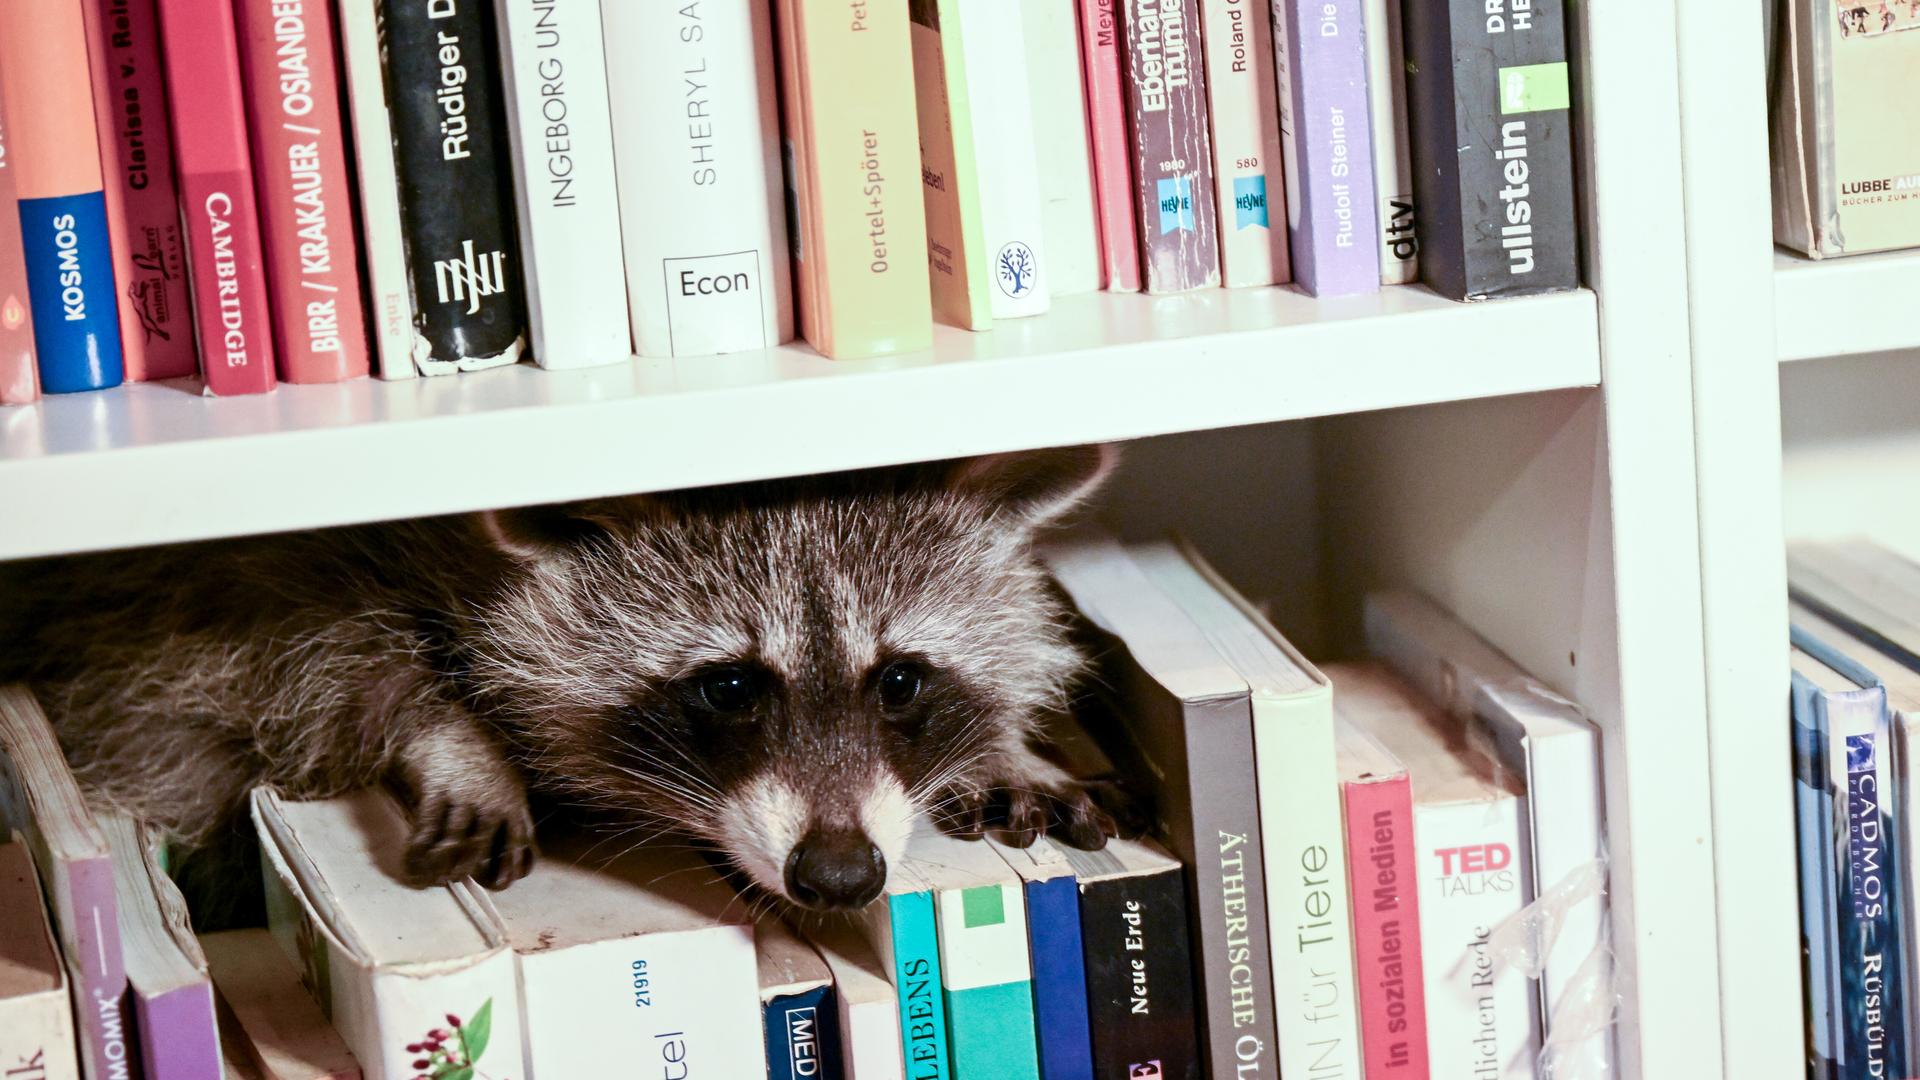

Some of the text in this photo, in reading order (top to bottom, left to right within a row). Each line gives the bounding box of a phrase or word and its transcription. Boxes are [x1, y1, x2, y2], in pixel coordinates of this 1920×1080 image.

[272, 0, 314, 117] OSIANDE
[1230, 10, 1246, 73] Roland
[1320, 4, 1339, 37] Die
[121, 88, 149, 190] Clarissa
[436, 30, 470, 161] Rüdiger
[532, 0, 576, 207] INGEBORG UN
[678, 1, 717, 186] SHERYL SA
[288, 141, 331, 274] KRAKAUER
[860, 129, 888, 274] Oertel+Spörer
[1236, 158, 1258, 169] 580
[1329, 106, 1353, 247] Rudolf Steiner
[1495, 121, 1535, 274] ullstein
[53, 214, 86, 321] KOSMOS
[205, 192, 247, 368] CAMBRIDGE
[680, 269, 750, 297] Econ
[1385, 199, 1417, 260] dtv
[306, 300, 339, 353] BIRR
[1298, 845, 1333, 953] Tiere
[1434, 842, 1511, 876] TED
[1436, 871, 1514, 898] TALKS
[1859, 774, 1882, 918] CADMOS
[632, 959, 651, 1007] 21919
[1122, 900, 1149, 1014] Neue Erde
[1218, 830, 1255, 1028] ÄTHERISCHE
[1370, 810, 1409, 1069] in sozialen Medien
[1466, 925, 1494, 989] Rede
[792, 1019, 818, 1076] MED
[1303, 967, 1339, 1024] für
[1863, 953, 1885, 1080] RÜSBÜLD
